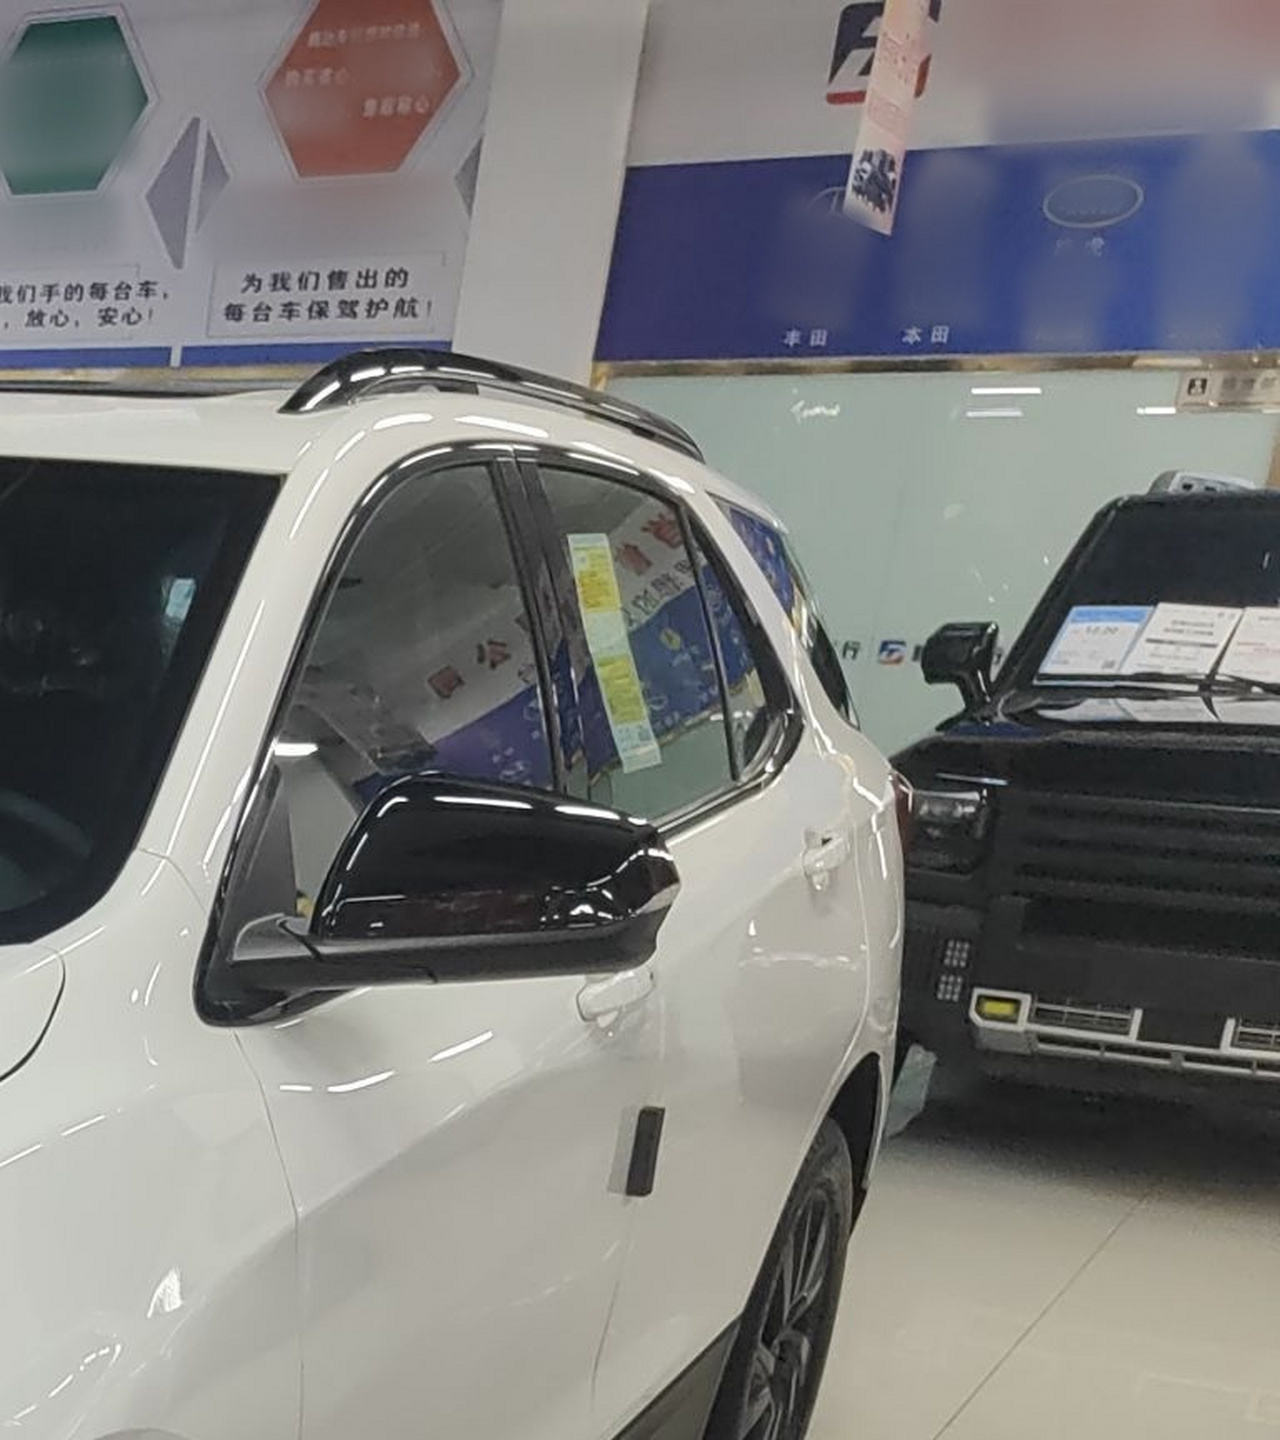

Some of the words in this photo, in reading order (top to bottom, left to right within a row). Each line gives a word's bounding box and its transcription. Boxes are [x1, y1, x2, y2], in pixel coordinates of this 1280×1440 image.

[241, 266, 410, 294] 为我们售出的
[902, 325, 949, 344] 本田
